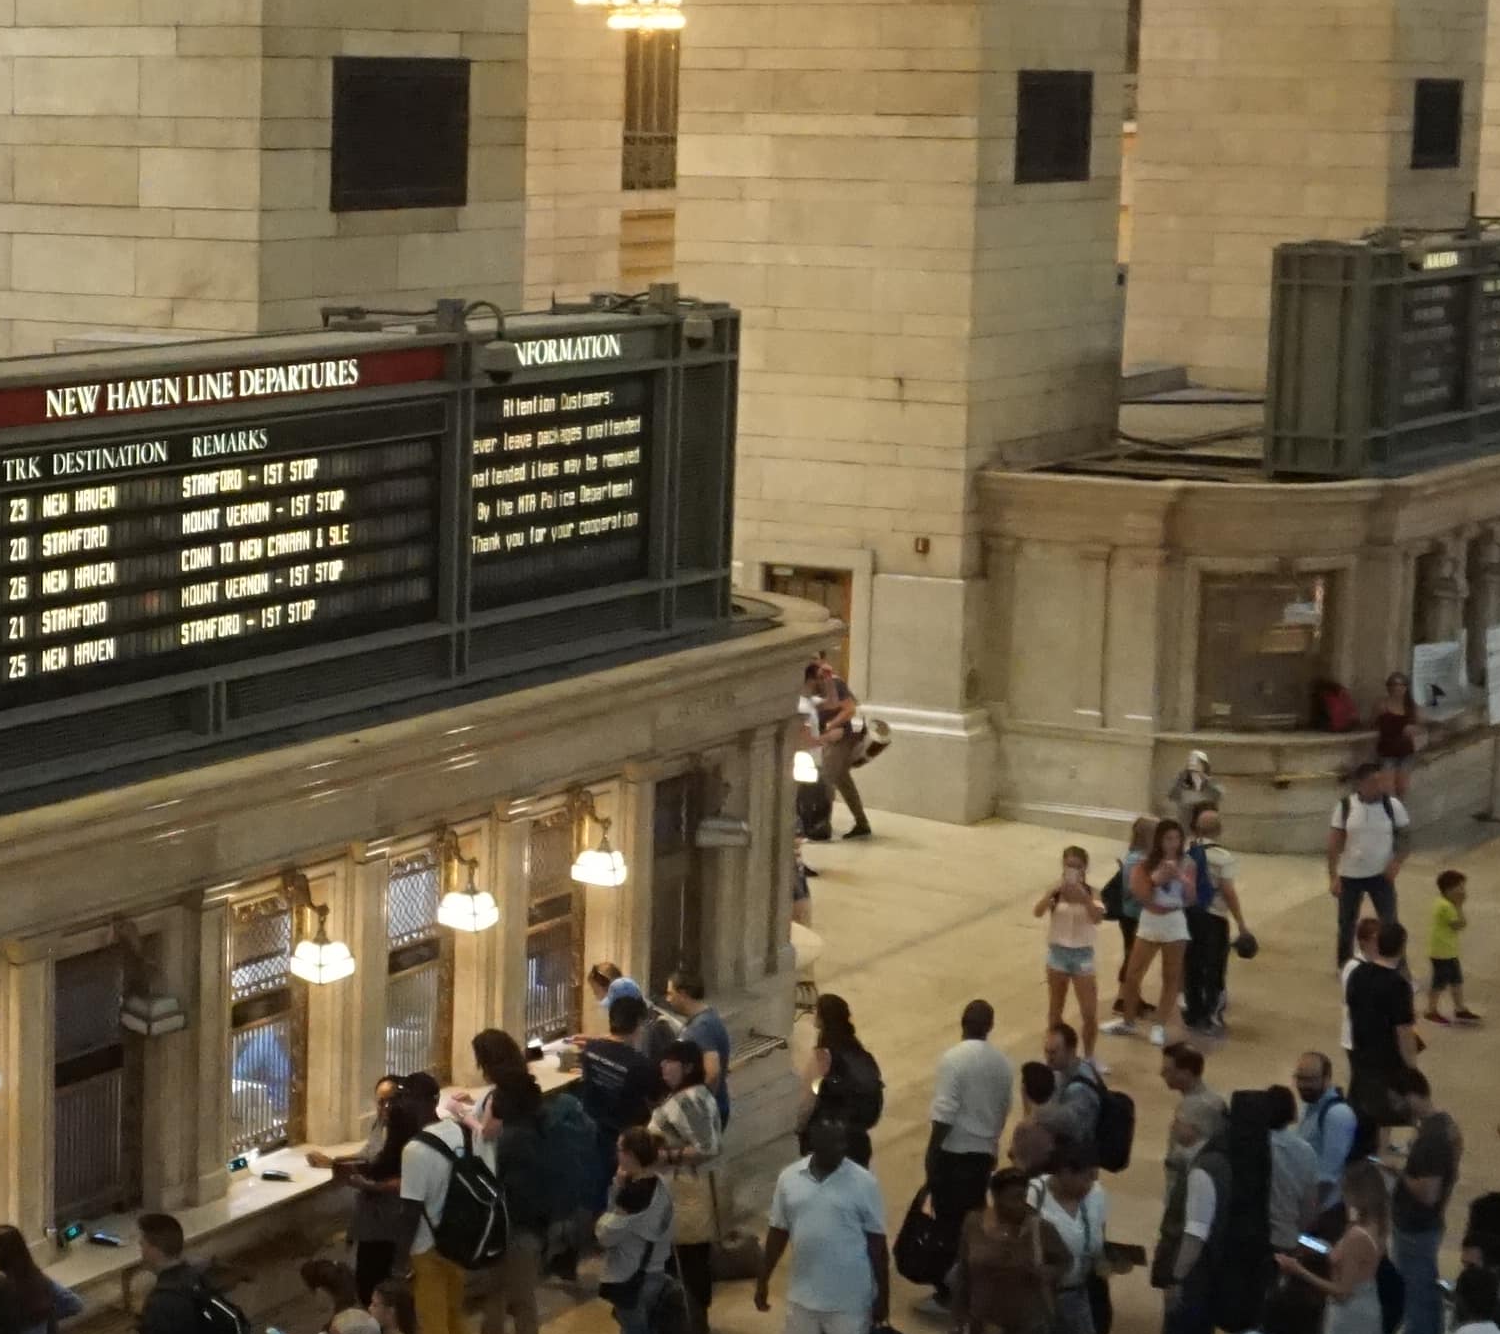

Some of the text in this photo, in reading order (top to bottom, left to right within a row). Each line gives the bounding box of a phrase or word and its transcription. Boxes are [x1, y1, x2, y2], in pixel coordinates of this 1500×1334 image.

[514, 334, 621, 366] NFORMATION
[47, 357, 358, 417] NEW HAVEN LINE DEPARTURES
[503, 391, 614, 418] Attention Customers:
[3, 457, 40, 481] TRK
[54, 442, 166, 475] DESTINATION
[193, 428, 267, 457] REMARKS
[10, 499, 28, 522] 23
[43, 493, 68, 517] NEW
[75, 486, 116, 512] HAVEN
[183, 469, 242, 497] STAMFORD
[264, 463, 284, 484] 1ST
[290, 459, 318, 481] STOP
[10, 538, 27, 561] 20
[43, 525, 107, 556] STAMFORD
[183, 508, 220, 534] MOUNT
[226, 502, 270, 527] VERNON
[291, 495, 310, 516] 1ST
[317, 490, 344, 512] STOP
[10, 577, 27, 600] 26
[43, 570, 68, 593] NEW
[75, 562, 115, 589] HAVEN
[182, 547, 212, 571] CONN
[220, 542, 234, 563] TO
[240, 539, 262, 560] NEW
[268, 530, 310, 557] CANAAN
[329, 524, 349, 545] SLE
[9, 616, 24, 639] 21
[42, 602, 106, 633] STAMFORD
[182, 582, 218, 607] MOUNT
[226, 573, 269, 599] VERNON
[290, 565, 309, 587] 1ST
[316, 560, 343, 582] STOP
[9, 655, 26, 678] 25
[42, 647, 67, 671] NEW
[74, 638, 114, 665] HAVEN
[181, 614, 240, 644] STAMFORD
[262, 606, 281, 628] 1ST
[288, 600, 315, 623] STOP
